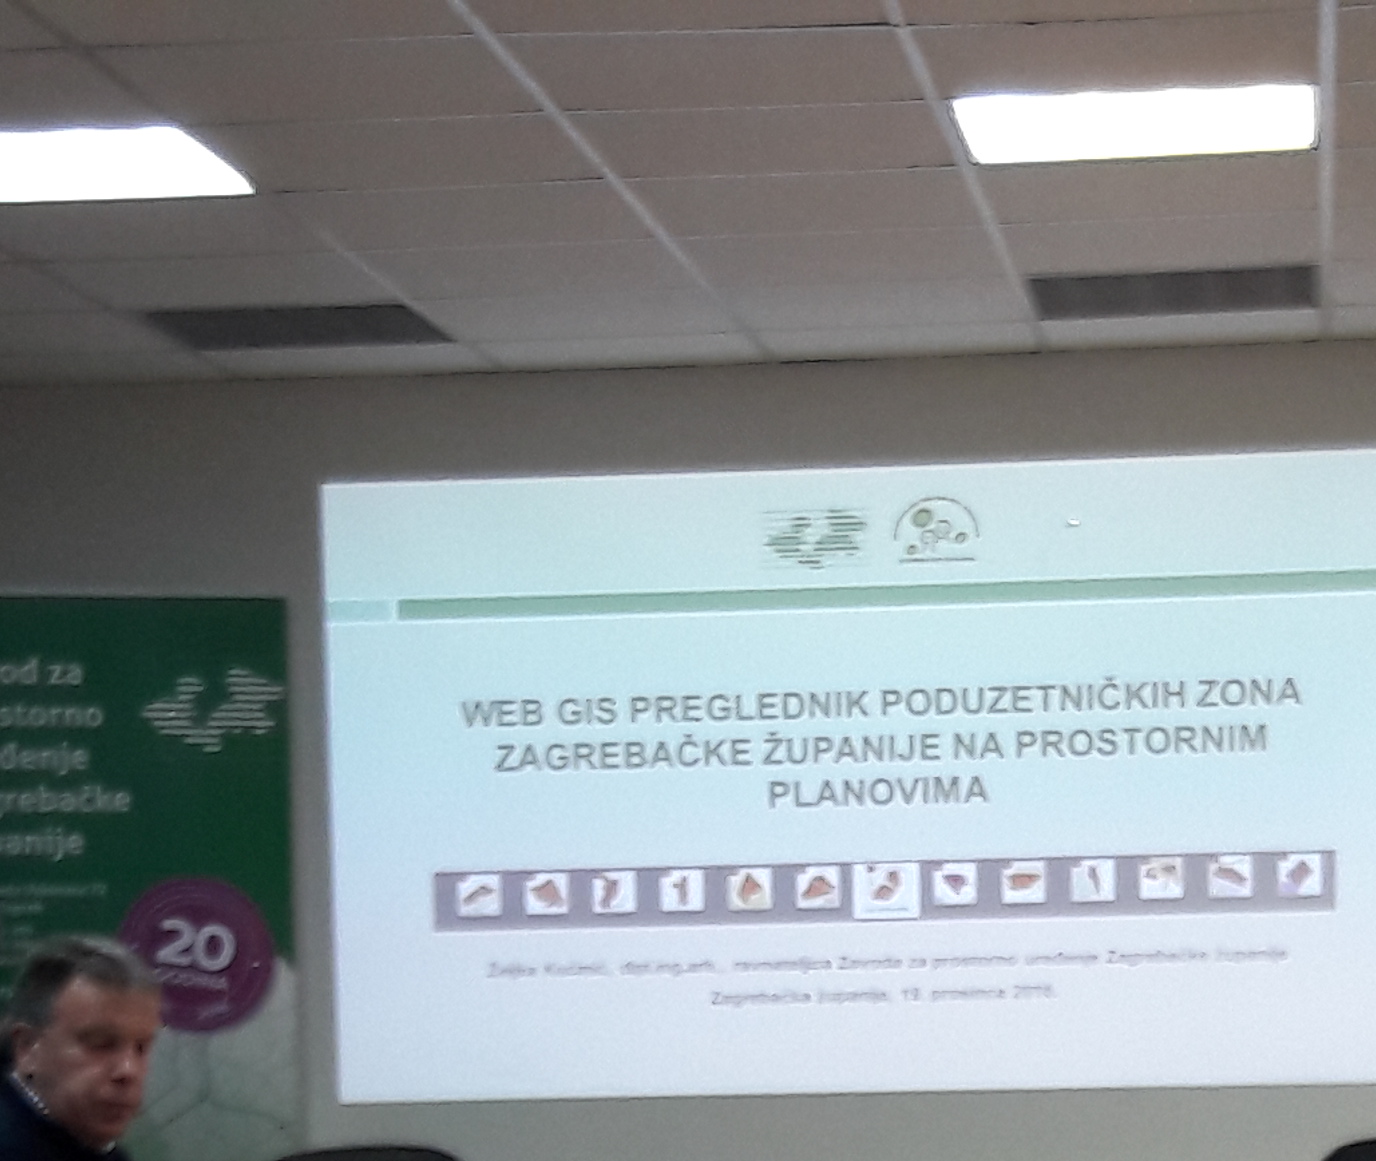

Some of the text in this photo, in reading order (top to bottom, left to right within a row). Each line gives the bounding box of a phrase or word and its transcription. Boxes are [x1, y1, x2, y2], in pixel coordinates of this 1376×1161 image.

[47, 664, 83, 685] za
[461, 675, 1302, 727] WEB GIS PREGLEDNIK PODUZETNIČKIH ZONA
[494, 723, 1268, 773] ZAGREBAČKE ŽUPANIJE NA PROSTORNIM
[768, 775, 989, 809] PLANOVIMA
[157, 919, 236, 972] 20
